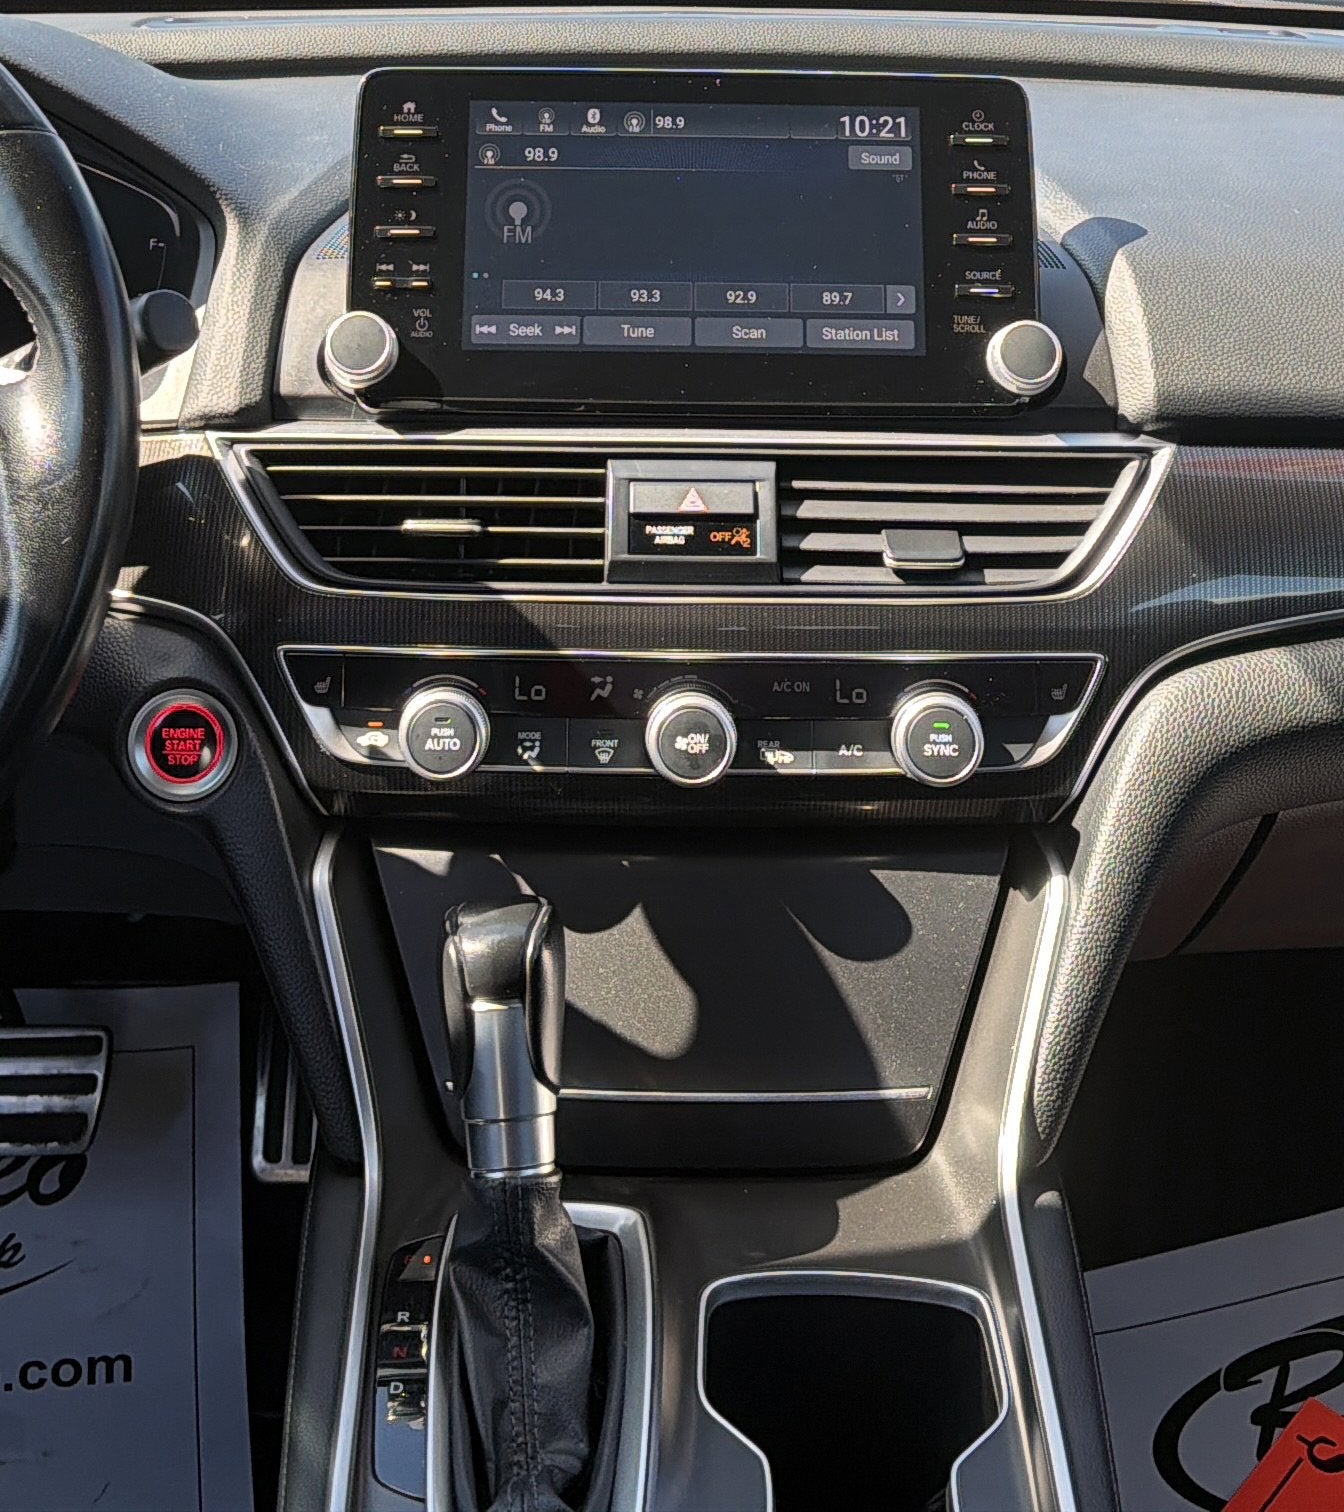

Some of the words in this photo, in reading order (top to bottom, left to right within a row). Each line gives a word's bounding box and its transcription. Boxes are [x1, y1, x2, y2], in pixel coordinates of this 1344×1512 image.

[394, 113, 424, 122] HOME
[656, 116, 685, 128] 98.9
[486, 124, 512, 133] Phone
[540, 124, 553, 132] FM
[581, 124, 606, 133] Audio
[839, 115, 907, 138] 10:21
[962, 121, 995, 131] CLOCK
[524, 147, 558, 161] 98.9
[861, 152, 900, 165] Sound
[393, 163, 420, 171] BACK
[963, 170, 997, 180] PHONE
[967, 220, 997, 230] AUDIO
[503, 226, 532, 243] FM
[965, 271, 1001, 280] SOURCE
[535, 289, 564, 302] 94.3
[631, 290, 661, 302] 93.3
[726, 291, 757, 303] 92.9
[822, 292, 852, 305] 89.7
[413, 309, 433, 317] VOL
[953, 316, 981, 324] TUNE/
[411, 330, 433, 338] AUDIO
[509, 324, 543, 337] Seek
[621, 325, 655, 338] Tune
[732, 326, 767, 340] Scan
[953, 324, 986, 333] SCROLL
[822, 327, 871, 341] Station
[874, 328, 899, 342] List
[645, 525, 694, 535] PASSENGER
[654, 535, 686, 545] AIRBAG
[710, 531, 732, 542] OFF
[514, 675, 546, 701] Lo
[772, 682, 792, 693] A/C
[794, 682, 810, 693] ON
[835, 679, 867, 704] Lo
[162, 728, 205, 739] ENGINE
[431, 728, 454, 737] PUSH
[517, 732, 542, 740] MODE
[929, 733, 952, 743] PUSH
[424, 738, 460, 751] AUTO
[591, 739, 619, 748] FRONT
[687, 734, 710, 744] ON/
[757, 740, 780, 748] REAR
[165, 740, 202, 751] START
[687, 744, 710, 754] OFF
[838, 744, 864, 756] A/C
[923, 744, 959, 757] SYNC
[168, 755, 199, 766] STOP
[397, 1311, 410, 1322] R
[393, 1346, 408, 1358] N
[390, 1381, 404, 1395] D
